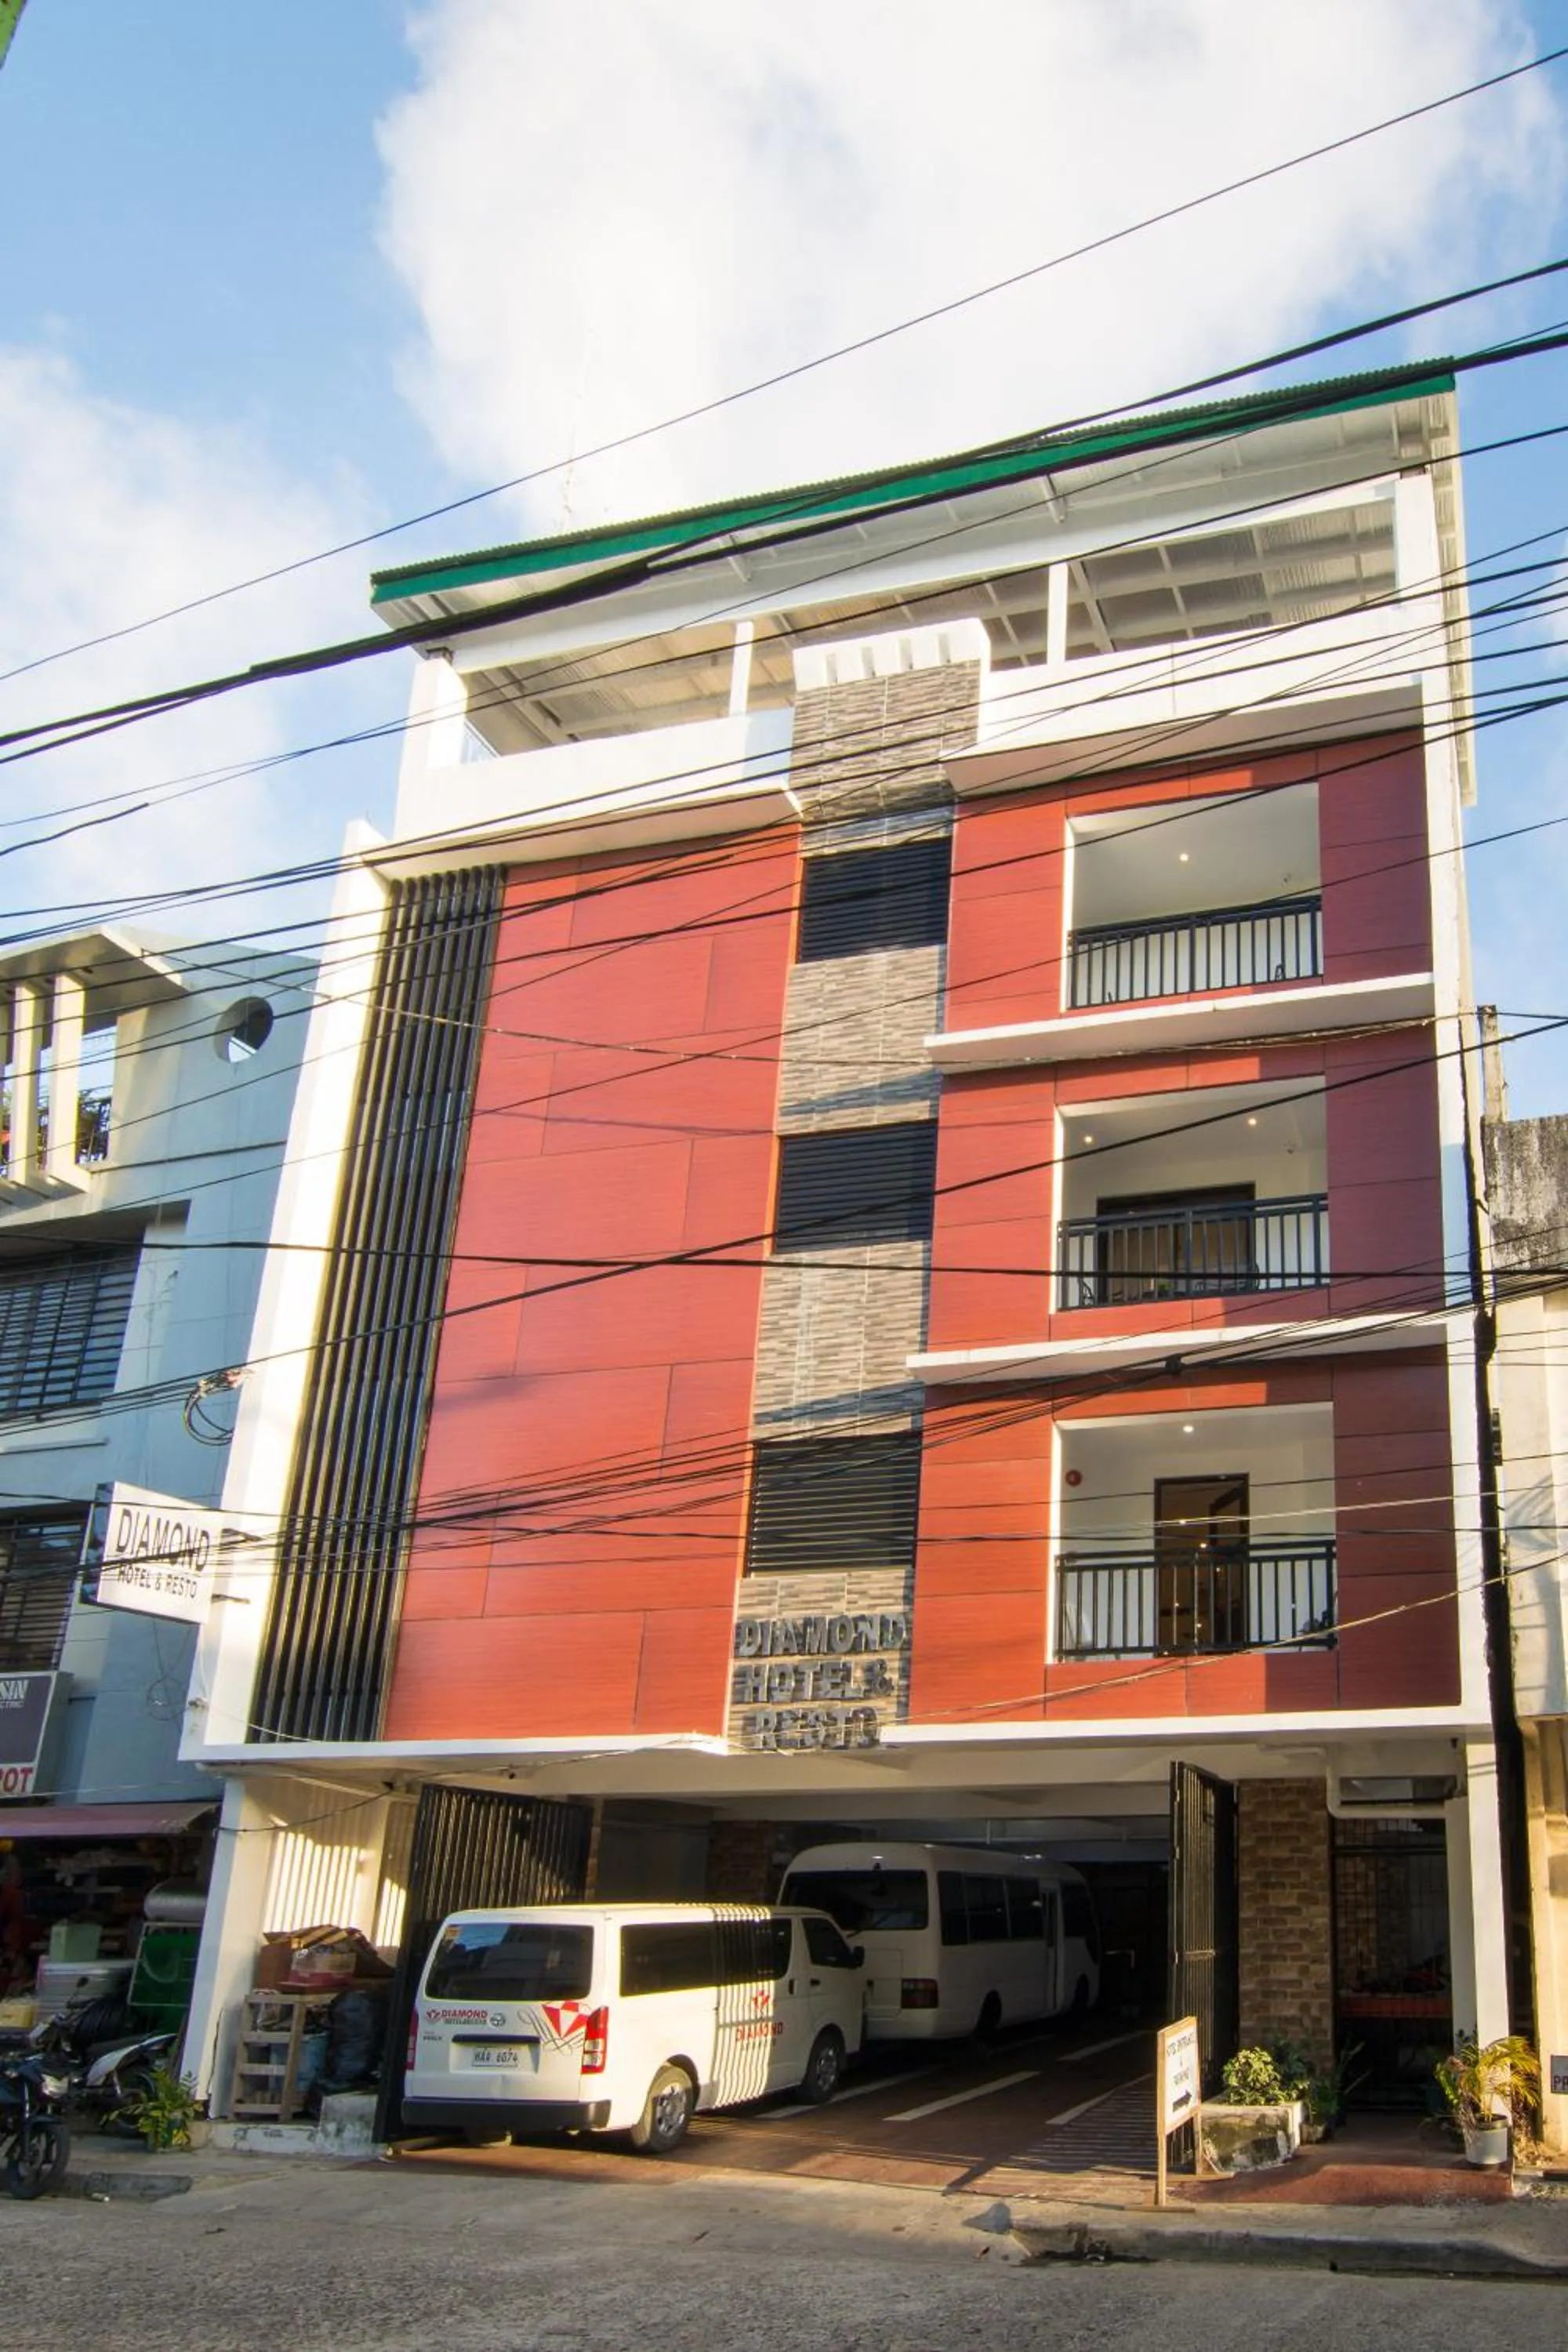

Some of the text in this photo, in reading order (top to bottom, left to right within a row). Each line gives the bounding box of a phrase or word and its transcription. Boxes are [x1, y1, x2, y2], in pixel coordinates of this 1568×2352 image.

[116, 1508, 209, 1571] DIAMOND
[118, 1564, 151, 1588] HOTEL
[165, 1573, 197, 1599] RESTO
[735, 1612, 906, 1657] DIAMOND
[732, 1658, 895, 1702] HOTEL &
[742, 1706, 880, 1749] RESTO
[0, 1767, 33, 1793] OT
[441, 2009, 488, 2018] DIAMOND
